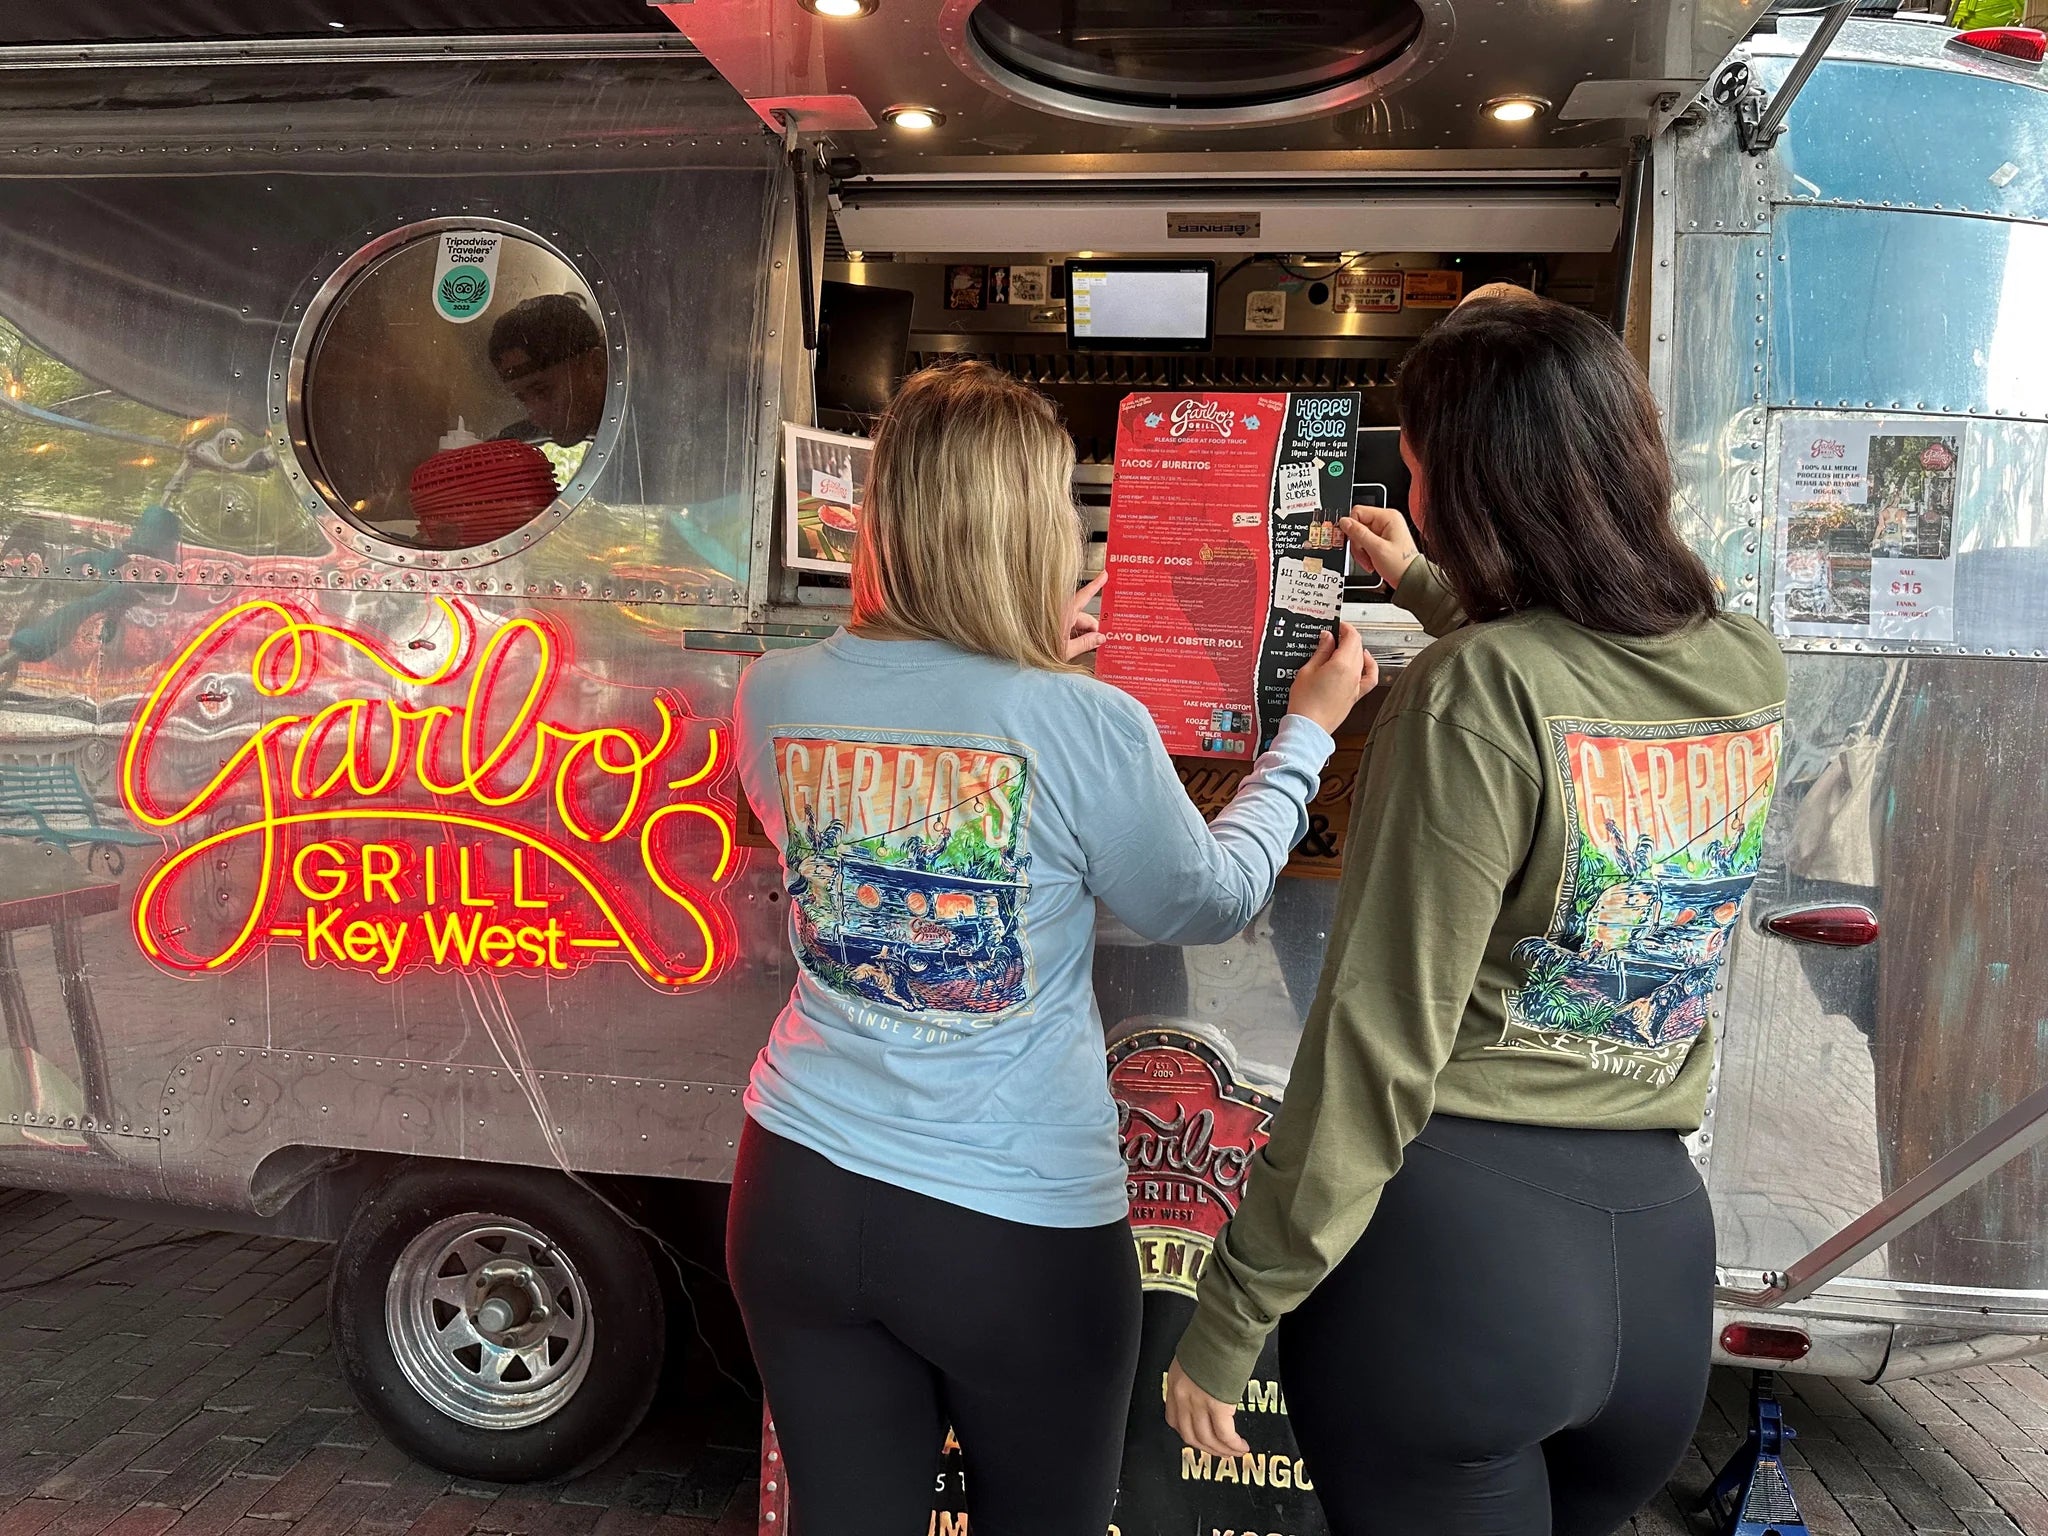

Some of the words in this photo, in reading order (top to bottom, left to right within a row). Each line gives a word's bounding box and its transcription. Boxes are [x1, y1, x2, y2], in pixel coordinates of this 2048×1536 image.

[1178, 224, 1245, 233] BERNER
[446, 238, 497, 246] Tripadvisor
[448, 246, 492, 254] Travelers'
[451, 255, 484, 263] Choice
[1340, 276, 1398, 286] WARNING
[1296, 398, 1351, 420] HAPPY
[1169, 399, 1234, 438] Garbo's
[1298, 420, 1346, 441] HOUR
[1292, 440, 1310, 449] Daily
[1291, 450, 1308, 458] 10pm
[1315, 450, 1347, 459] Midnight
[1120, 459, 1153, 468] TACOS
[1154, 460, 1160, 468] /
[1162, 460, 1210, 470] BURRITOS
[1288, 480, 1312, 491] UMAMI
[1285, 488, 1316, 500] SLIDERS
[1110, 554, 1155, 564] BURGERS
[1156, 556, 1163, 564] /
[1164, 556, 1193, 566] DOGS
[1298, 570, 1317, 580] Taco
[1323, 574, 1338, 584] Trio
[1891, 582, 1922, 594] $15
[1106, 632, 1133, 642] CAYO
[1136, 634, 1164, 644] BOWL
[1174, 636, 1216, 648] LOBSTER
[1218, 638, 1243, 648] ROLL
[122, 596, 733, 986] Garbo's
[785, 742, 1022, 852] GARBO'S
[292, 842, 552, 910] GRILL
[305, 906, 408, 975] Key
[422, 911, 568, 970] West
[848, 1007, 900, 1033] SINCE
[1590, 1052, 1645, 1080] SINCE
[1152, 1069, 1174, 1078] 2009
[1126, 1182, 1208, 1204] GRILL
[1132, 1206, 1156, 1220] KEY
[1160, 1207, 1194, 1221] WEST
